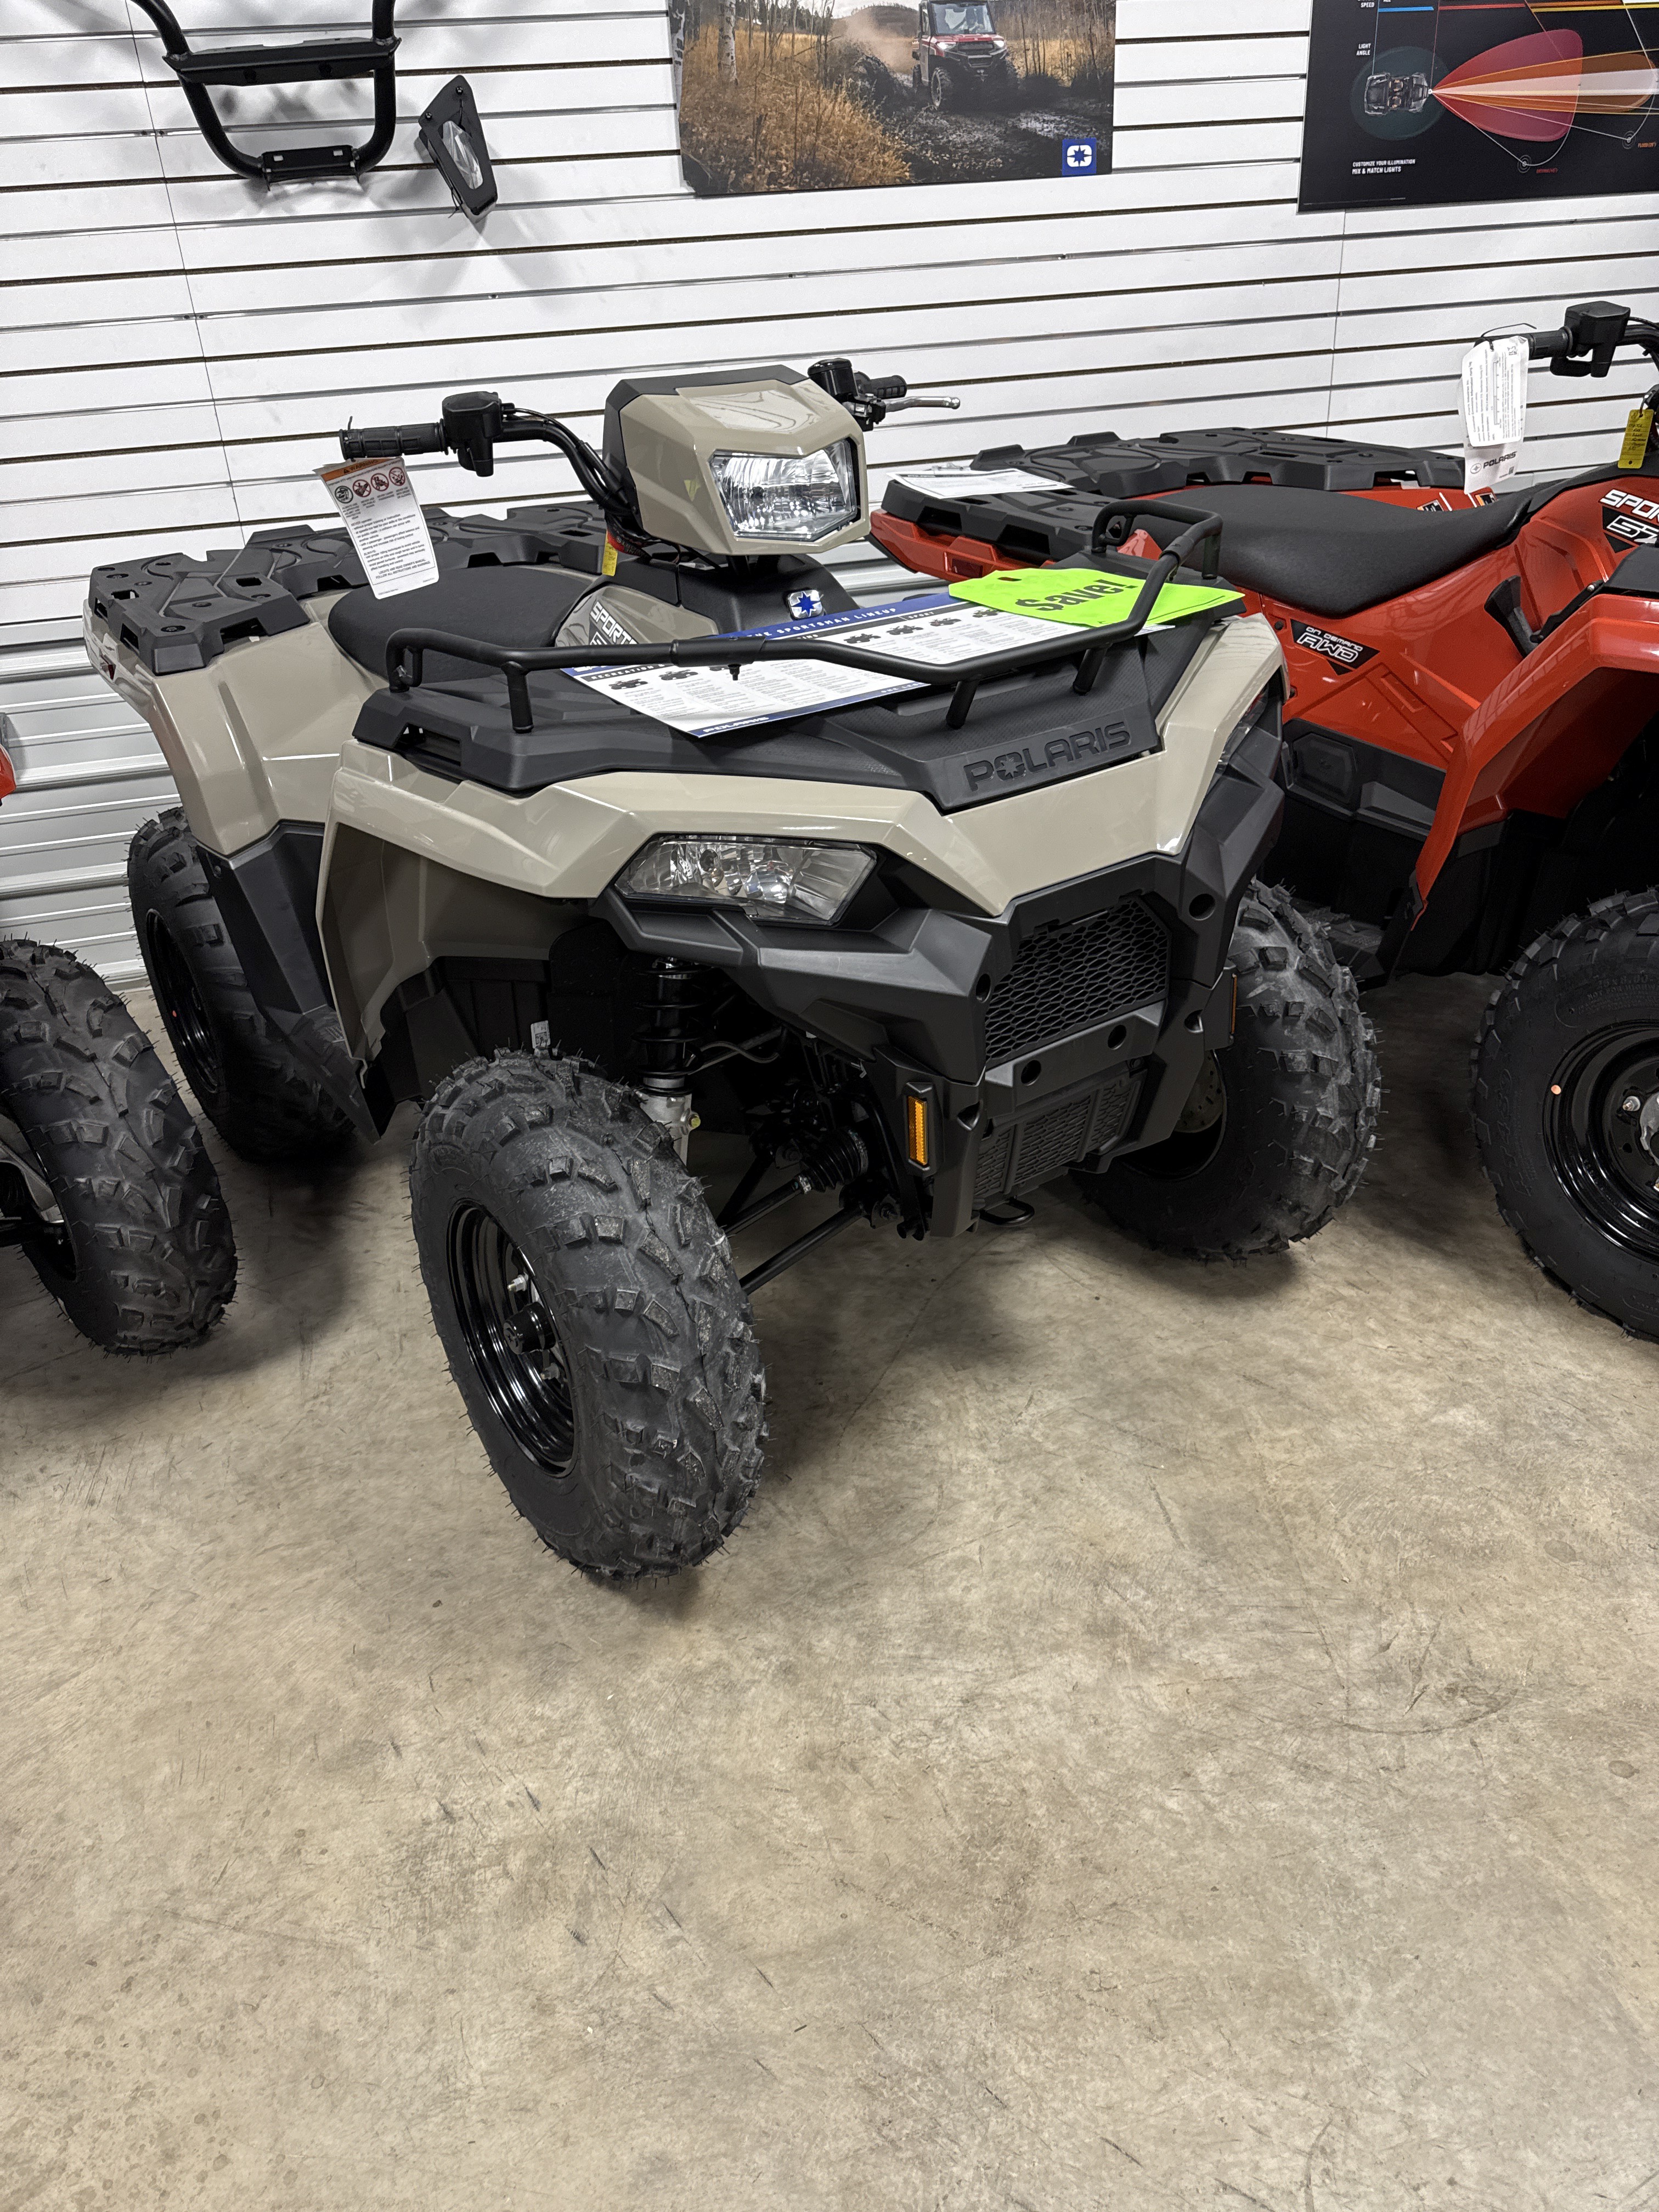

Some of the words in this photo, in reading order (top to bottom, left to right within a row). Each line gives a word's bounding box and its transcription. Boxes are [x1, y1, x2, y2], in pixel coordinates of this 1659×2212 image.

[1483, 451, 1517, 469] POLARIS
[777, 617, 850, 634] SPORTSMAN
[854, 607, 896, 619] LINEUP
[1296, 633, 1359, 663] AWD
[1306, 626, 1321, 635] ON
[1323, 633, 1363, 652] DEMAND
[591, 665, 654, 680] RECREATION
[703, 716, 770, 732] POLARIS
[963, 721, 1131, 792] POLARIS
